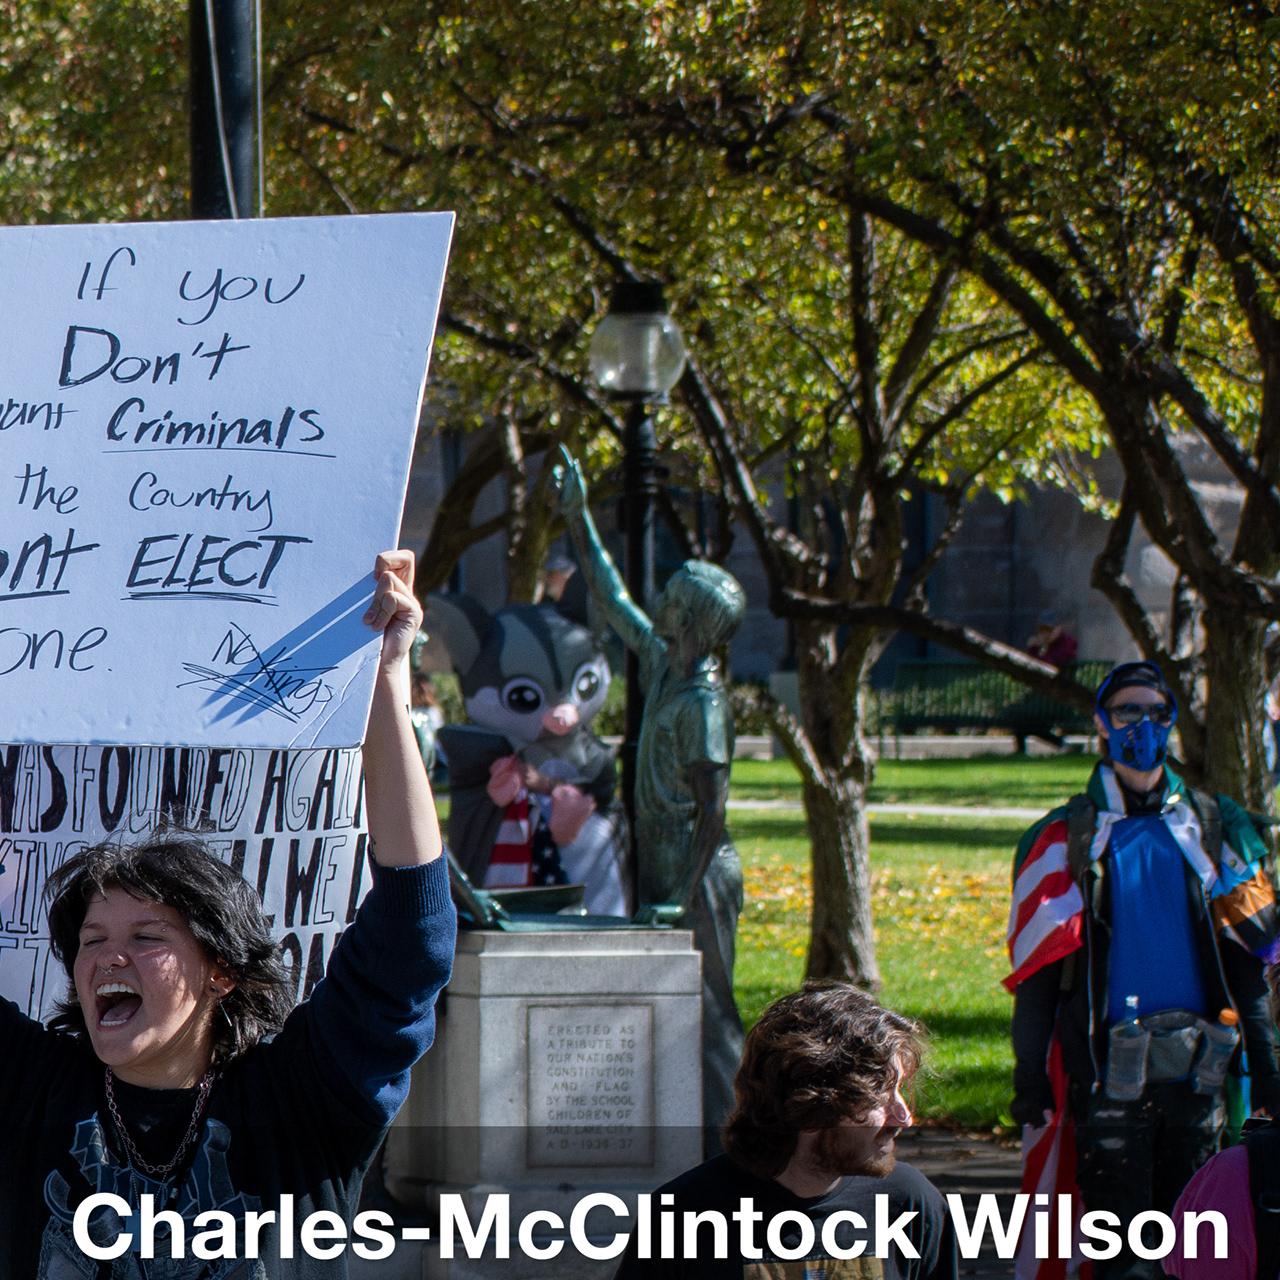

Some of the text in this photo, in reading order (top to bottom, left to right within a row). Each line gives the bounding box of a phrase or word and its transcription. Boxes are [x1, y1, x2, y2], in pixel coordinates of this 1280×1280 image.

[177, 268, 306, 325] you
[58, 325, 251, 388] Don't
[106, 397, 325, 449] Criminals
[14, 464, 80, 514] the
[129, 471, 273, 533] Country
[126, 532, 312, 590] ELECT
[73, 745, 255, 833] FOUNDED
[547, 1024, 635, 1036] ERECTED AS
[546, 1038, 636, 1050] A TRIBUTE TO
[546, 1052, 572, 1063] OUR
[546, 1066, 635, 1078] CONSTITUTION
[551, 1081, 630, 1092] AND FLAG
[546, 1095, 635, 1106] BY THE SCHOOL
[547, 1109, 632, 1120] CHILDREN OF
[546, 1123, 570, 1135] SALT
[606, 1124, 633, 1135] CITY
